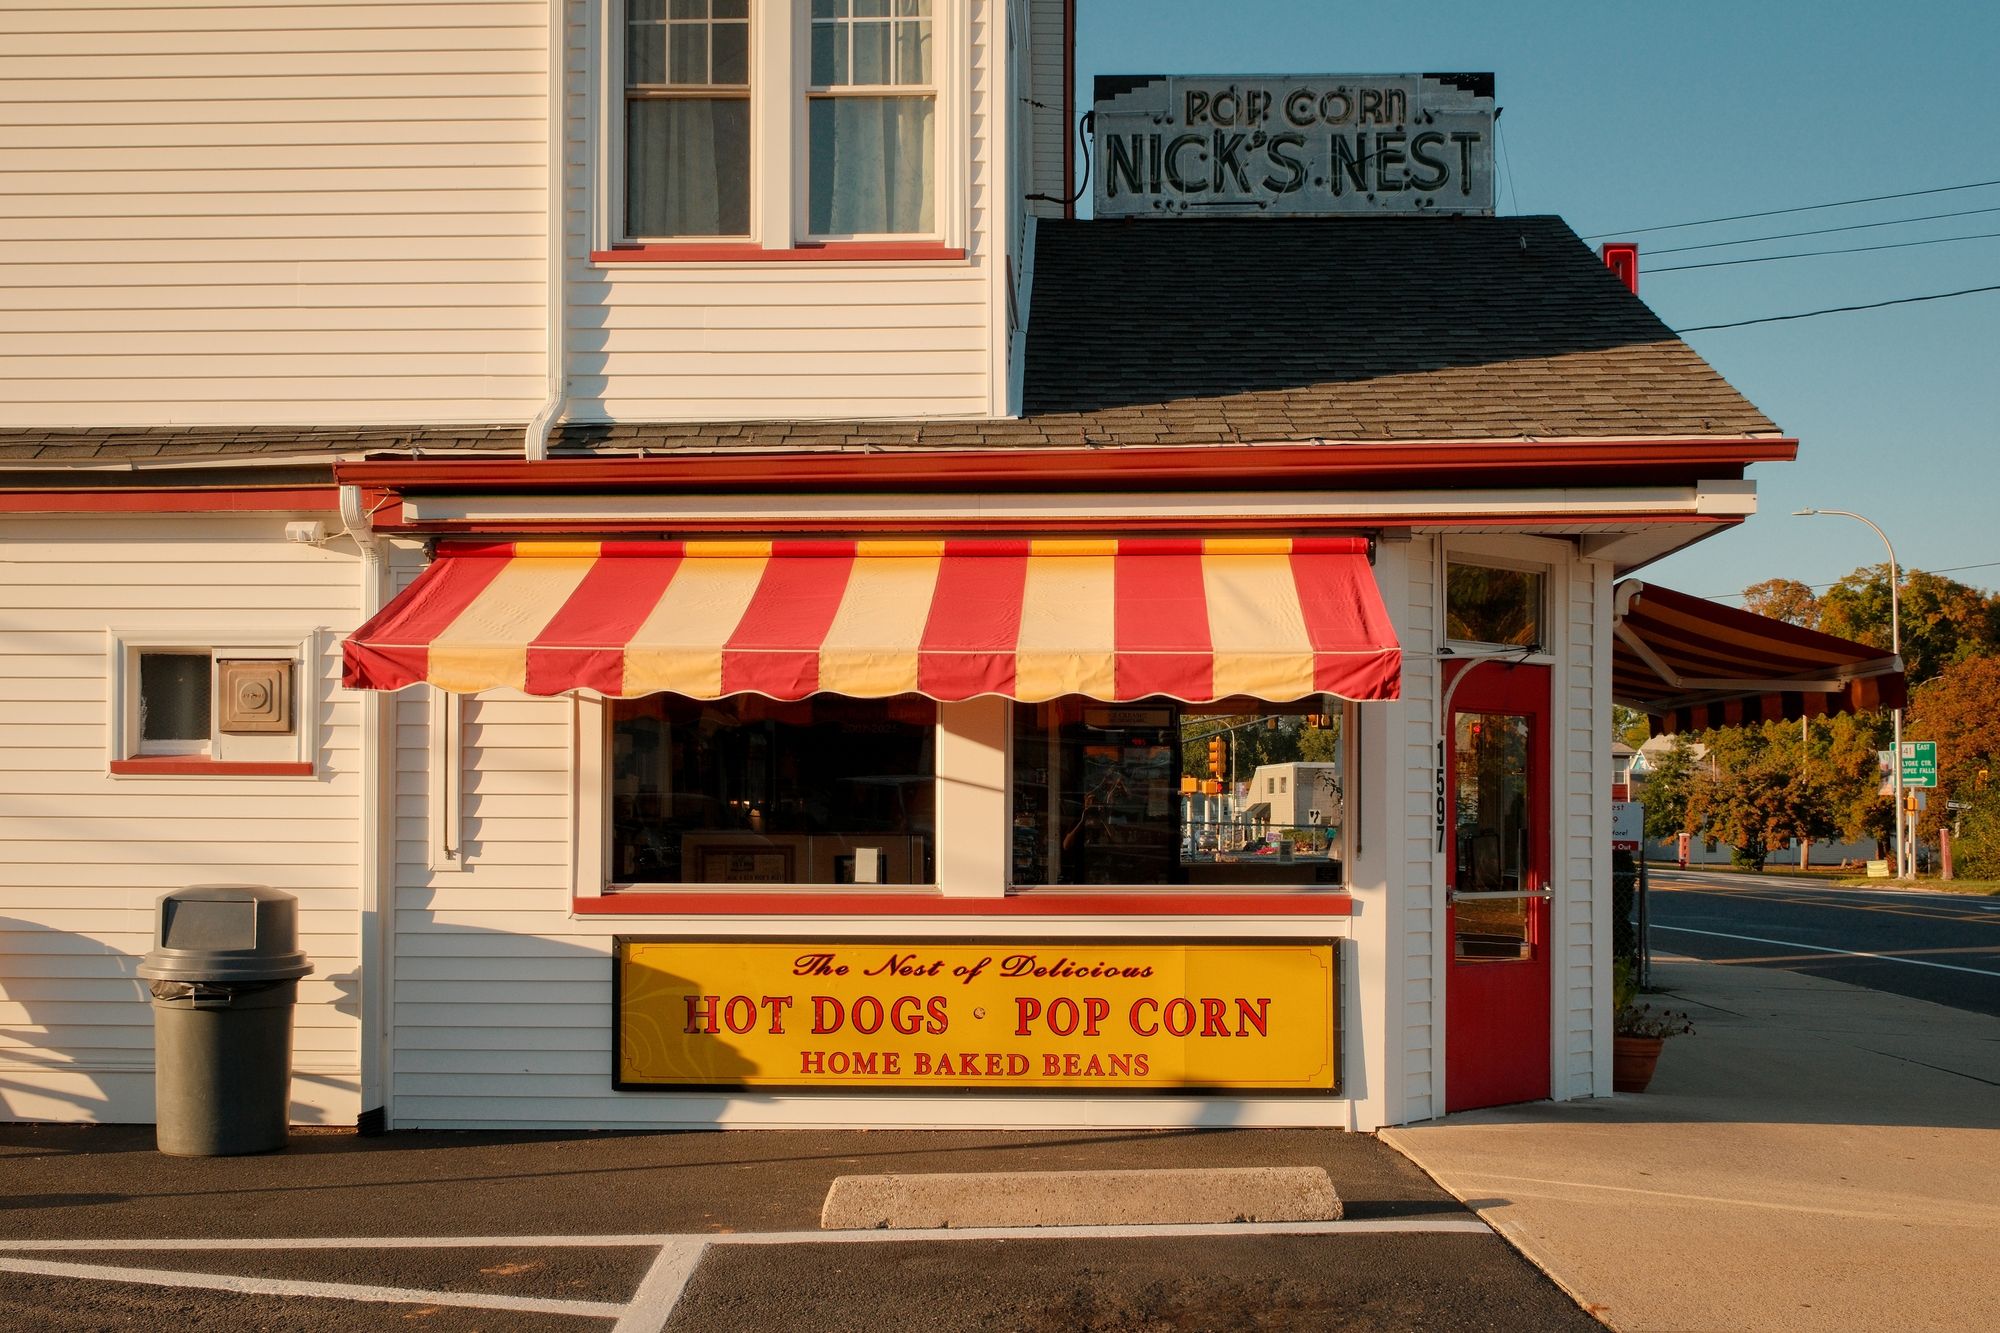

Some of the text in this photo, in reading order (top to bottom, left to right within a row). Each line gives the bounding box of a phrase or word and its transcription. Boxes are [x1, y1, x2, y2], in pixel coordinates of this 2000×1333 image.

[1185, 86, 1407, 127] POP CORN
[1106, 131, 1481, 195] NICK'S NEST
[1436, 740, 1445, 853] 1597
[793, 953, 1154, 984] The Nest of Delicious
[683, 995, 1271, 1038] HOT DOGS POP CORN
[800, 1051, 1150, 1078] HOME BAKED BEANS
